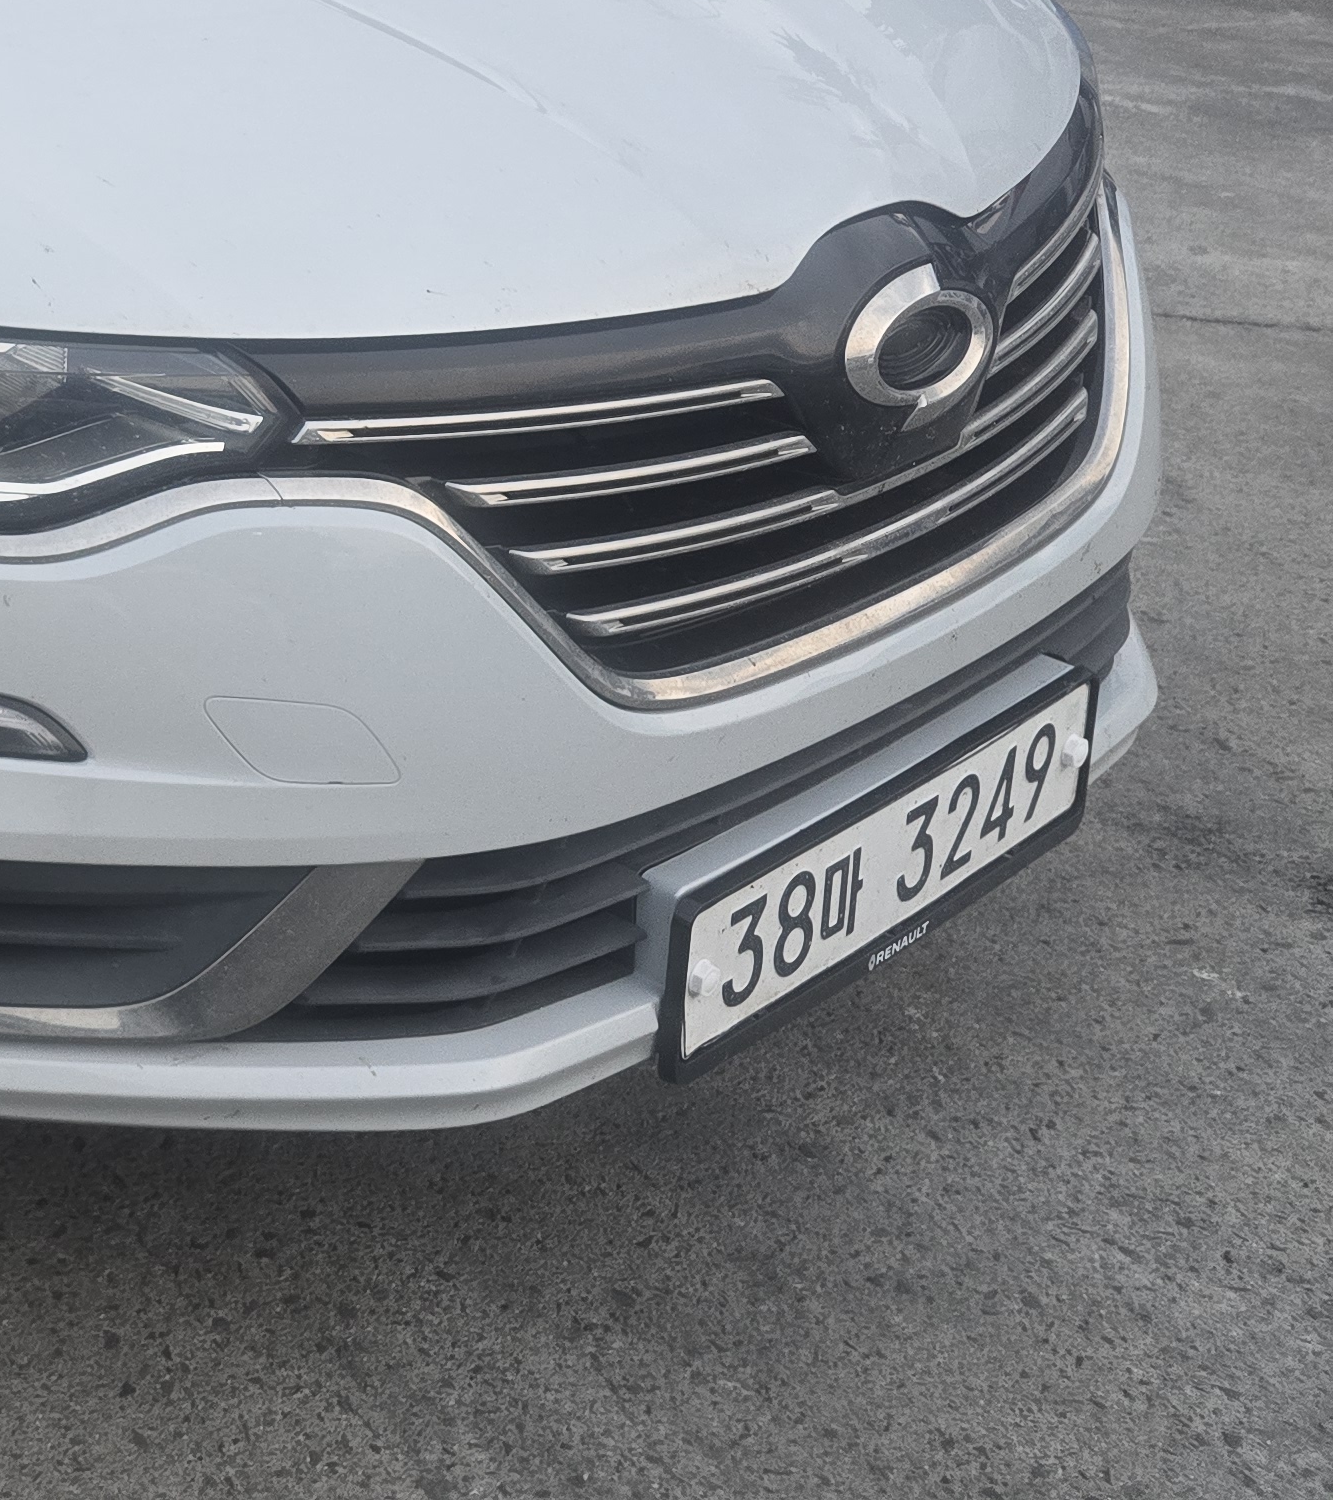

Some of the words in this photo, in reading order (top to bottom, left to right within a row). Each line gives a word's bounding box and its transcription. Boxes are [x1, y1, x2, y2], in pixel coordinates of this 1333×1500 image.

[721, 846, 864, 1008] 38마
[895, 722, 1057, 903] 3249
[875, 920, 930, 966] RENAULT
